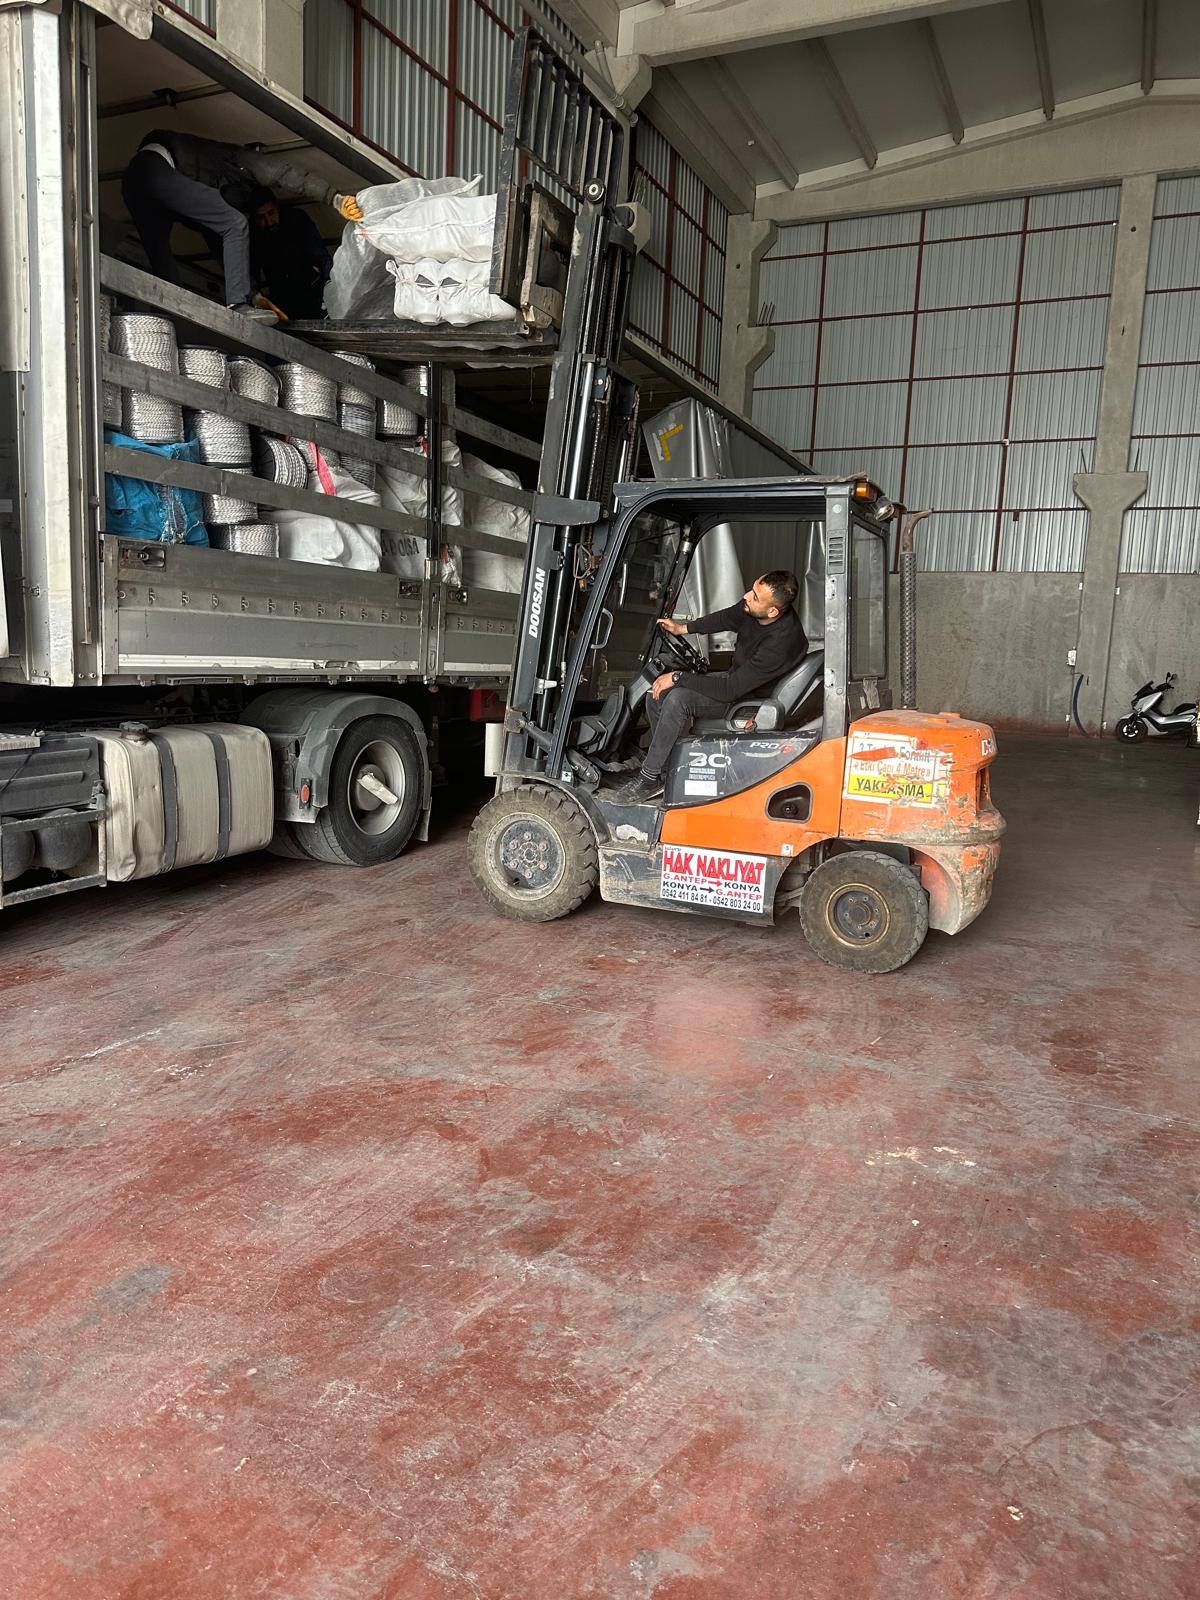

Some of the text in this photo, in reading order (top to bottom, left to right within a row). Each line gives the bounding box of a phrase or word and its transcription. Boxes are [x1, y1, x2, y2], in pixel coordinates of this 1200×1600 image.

[529, 567, 546, 639] DOOSAN
[663, 850, 694, 875] HAK
[662, 880, 762, 900] KONYA G.ANTEP
[663, 873, 761, 892] G.ANTEP KONYA
[662, 888, 677, 898] 0542
[678, 890, 689, 900] 411
[691, 892, 699, 901] 84
[699, 894, 708, 903] 81
[712, 895, 728, 906] 0542
[729, 899, 741, 908] 803
[743, 900, 751, 910] 24
[752, 902, 761, 911] 00
